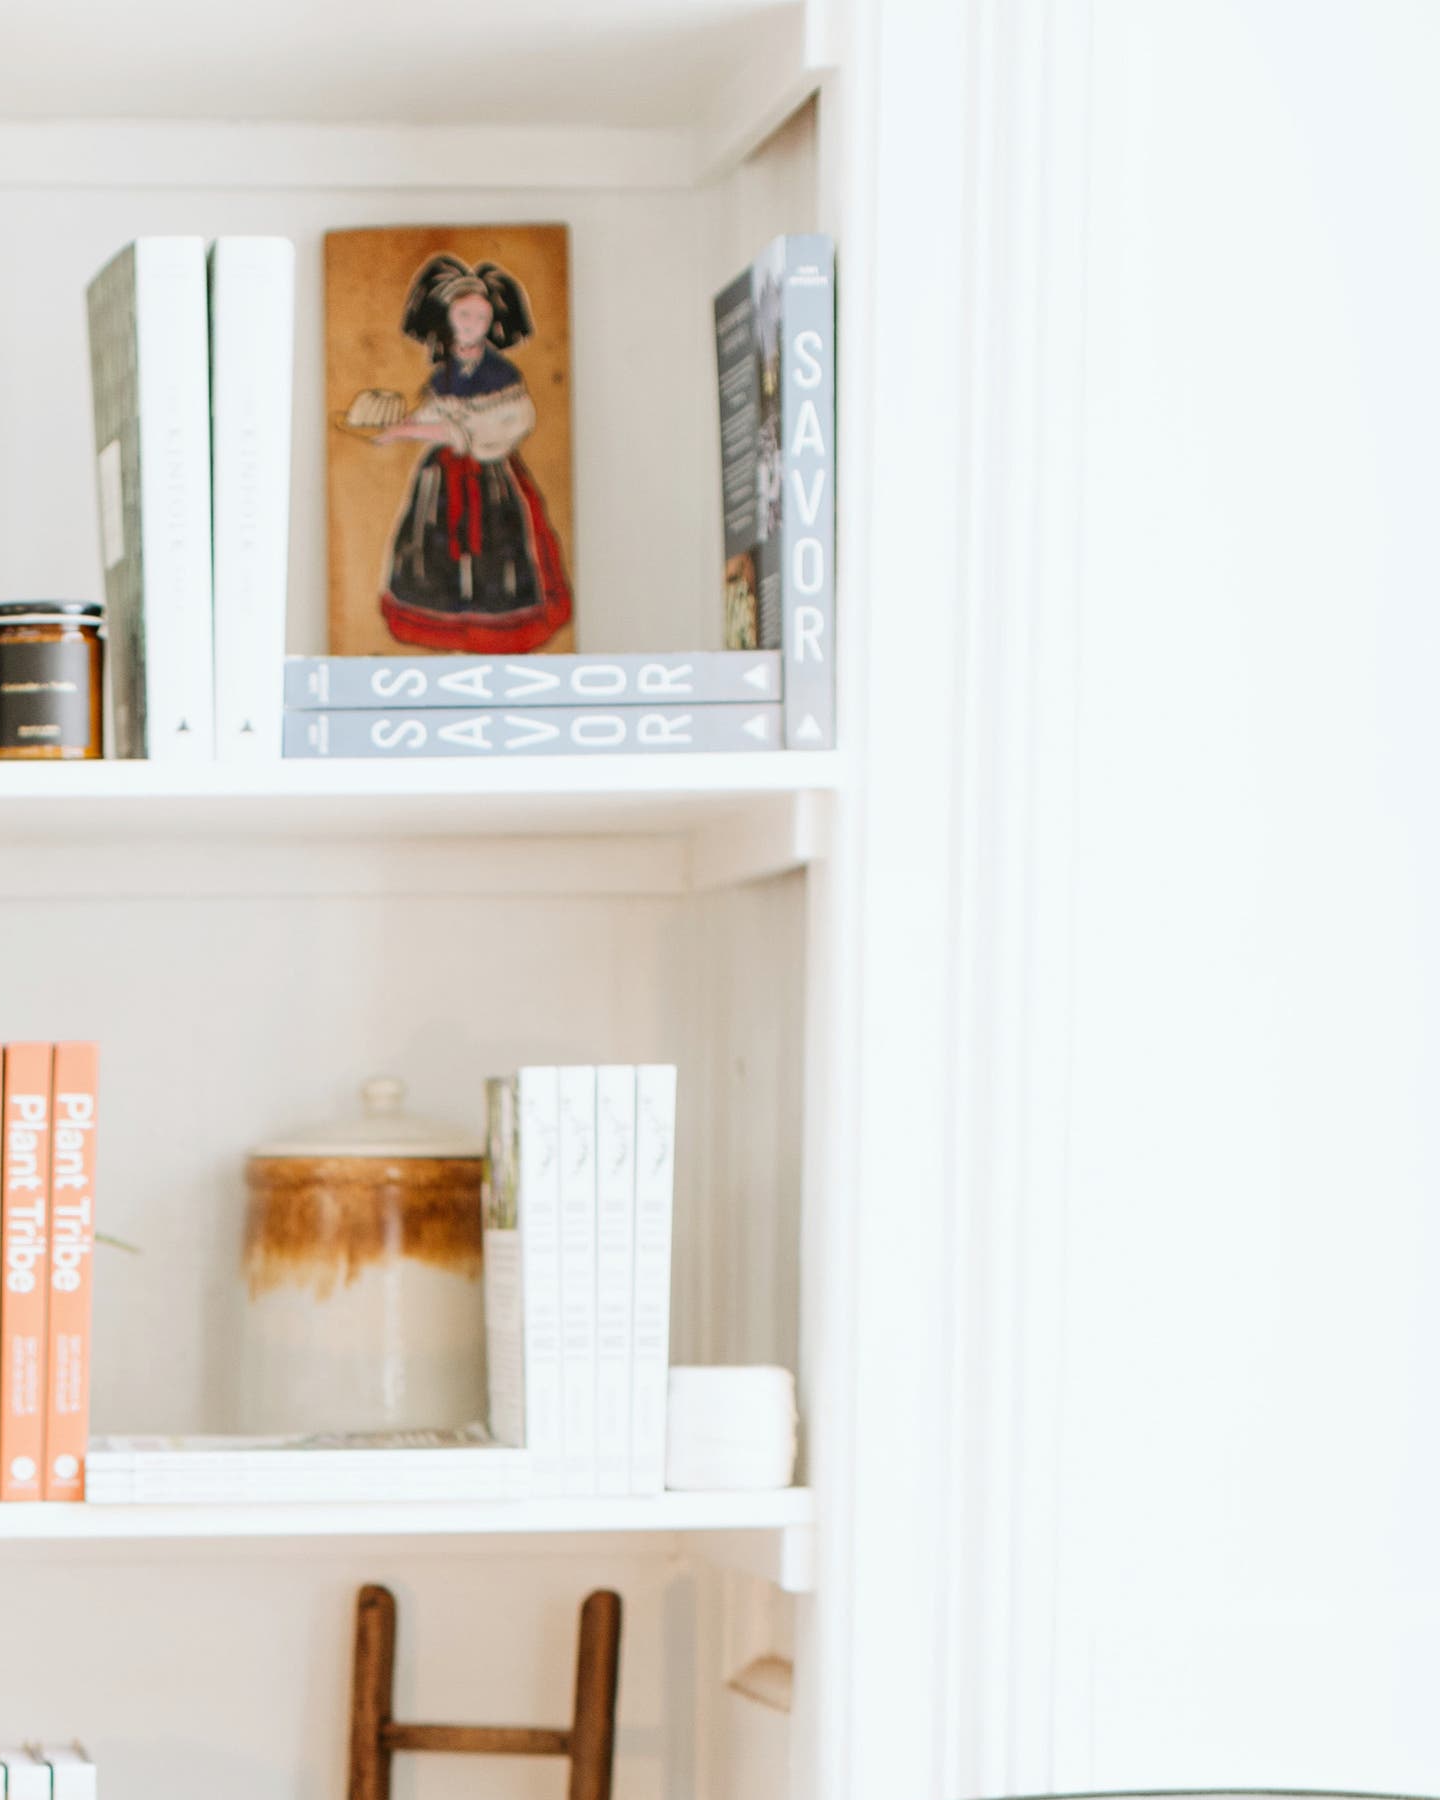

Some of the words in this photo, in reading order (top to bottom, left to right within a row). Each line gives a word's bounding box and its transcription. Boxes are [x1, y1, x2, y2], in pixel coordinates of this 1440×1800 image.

[792, 330, 826, 663] SAVOR
[371, 664, 692, 698] SAVOR
[371, 714, 692, 749] SAVOR
[8, 1094, 48, 1190] Plant
[54, 1092, 94, 1190] Plant
[8, 1198, 48, 1293] Tribe
[53, 1196, 91, 1292] Tribe
